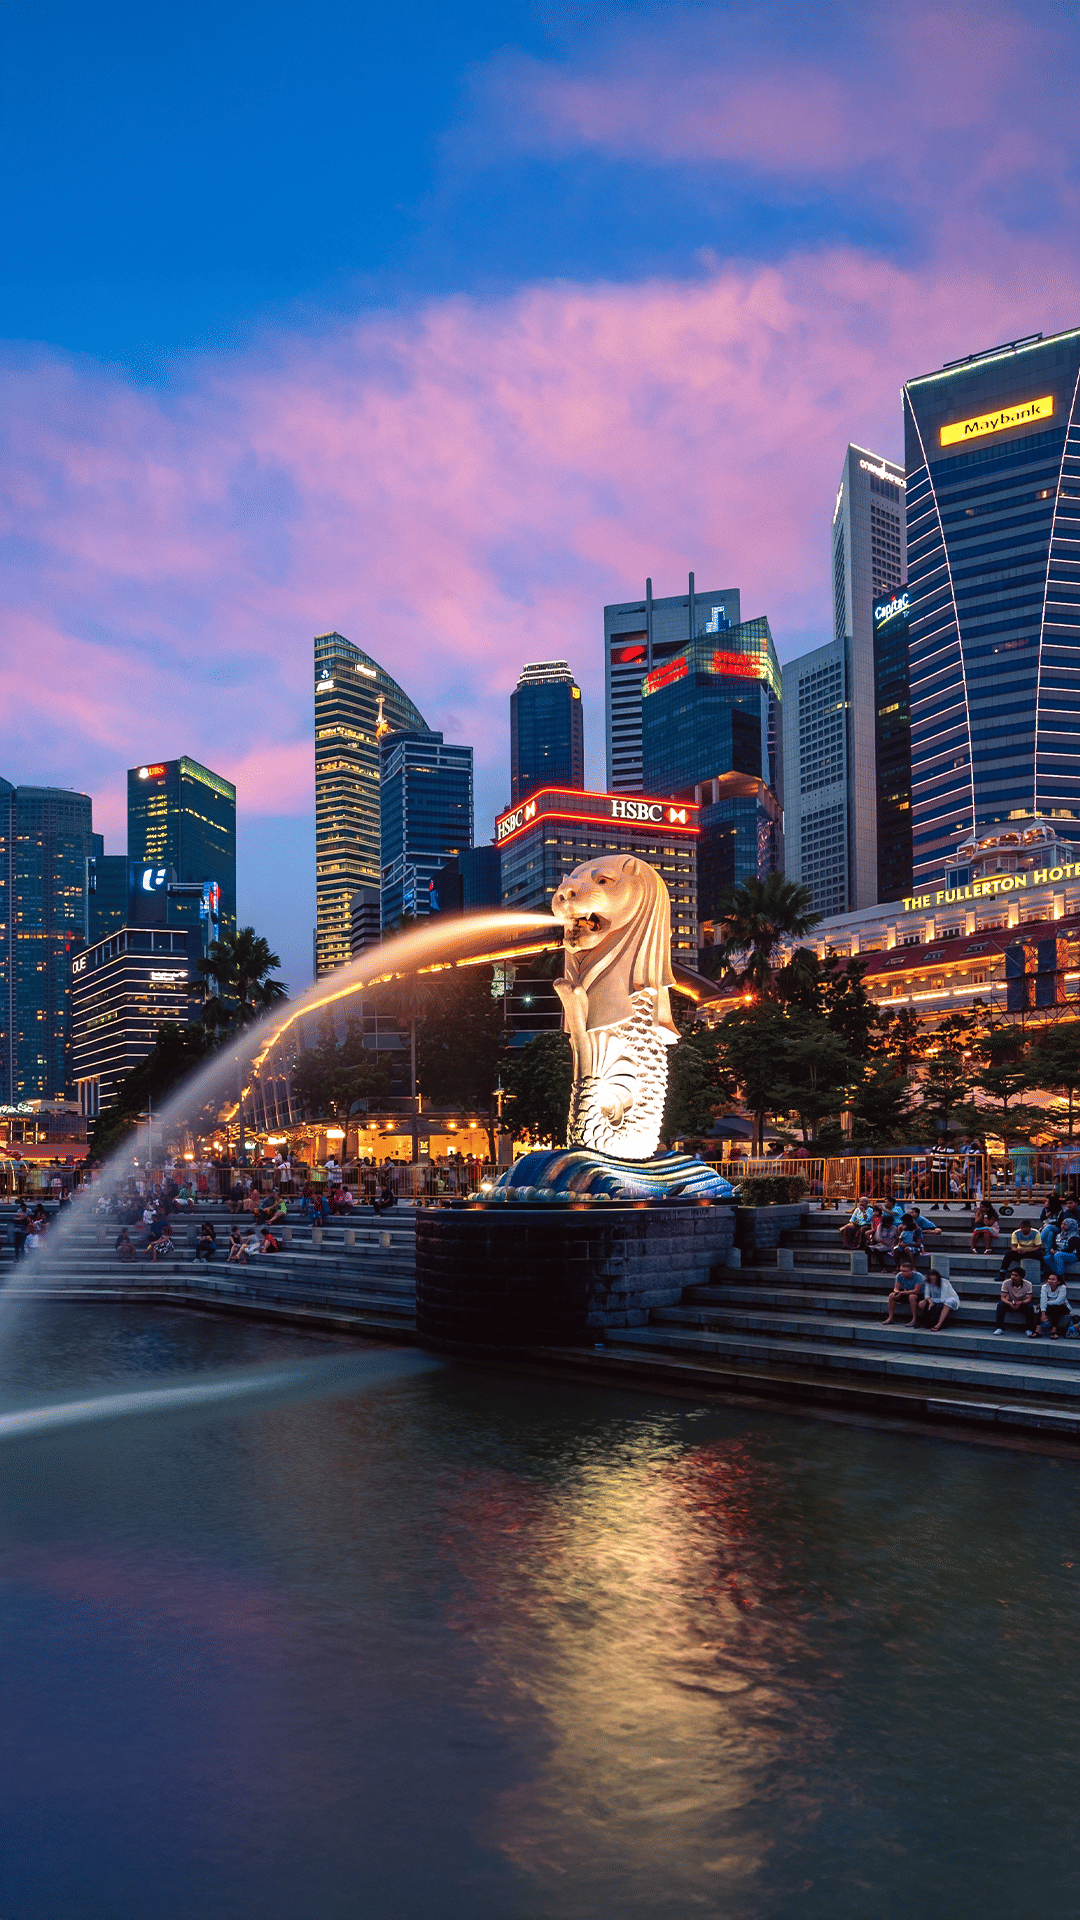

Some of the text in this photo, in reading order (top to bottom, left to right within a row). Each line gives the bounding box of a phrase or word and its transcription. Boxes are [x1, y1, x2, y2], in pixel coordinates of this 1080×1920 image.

[964, 404, 1041, 434] Maybank
[498, 809, 523, 840] HSBC
[611, 799, 663, 822] HSBC
[902, 894, 931, 911] THE
[936, 874, 1027, 904] FULLERTON
